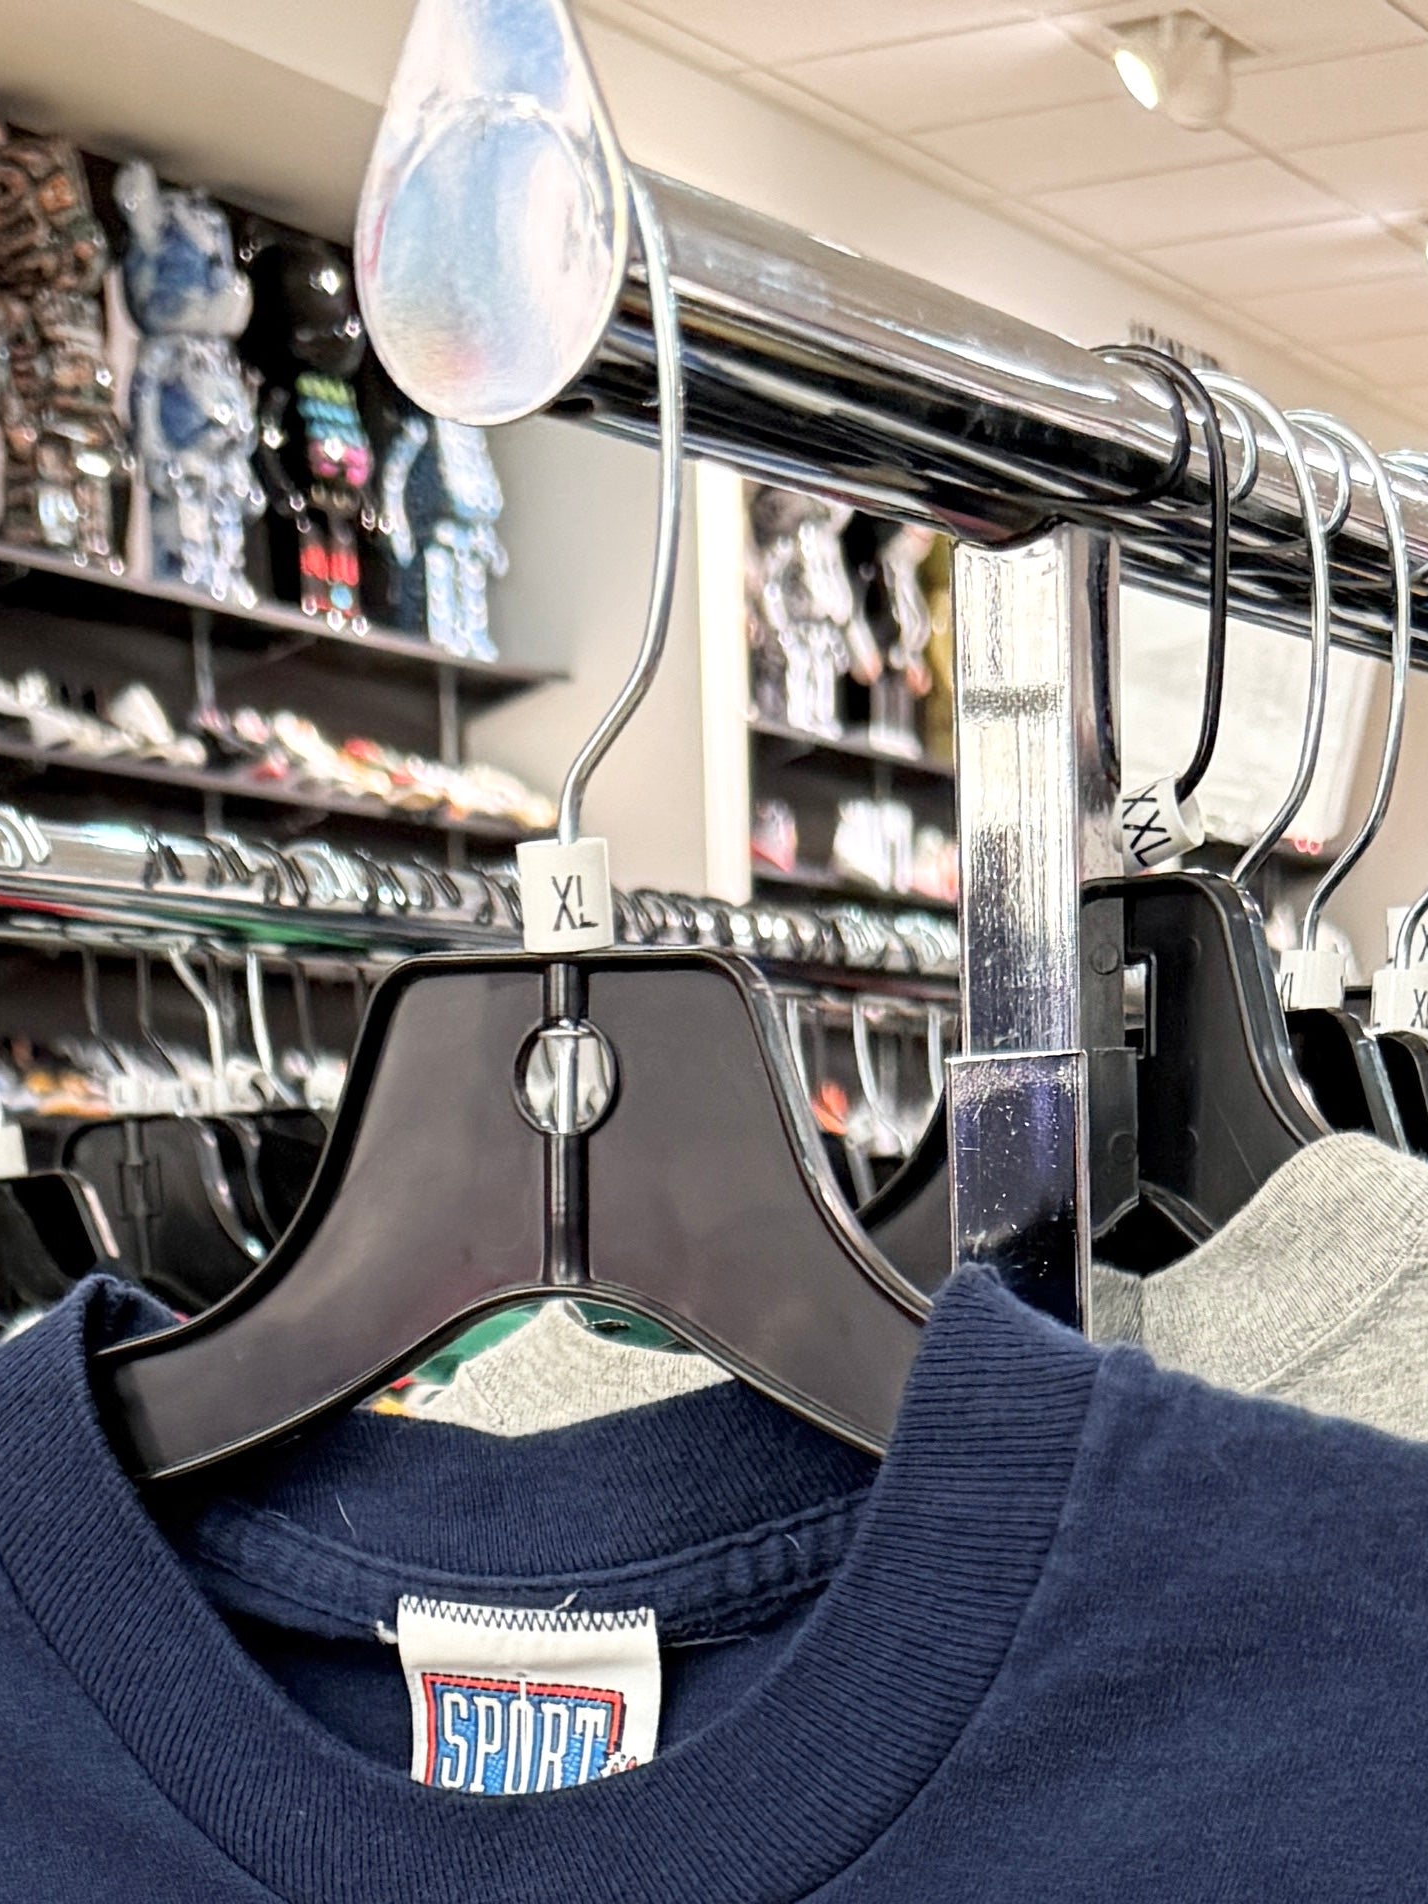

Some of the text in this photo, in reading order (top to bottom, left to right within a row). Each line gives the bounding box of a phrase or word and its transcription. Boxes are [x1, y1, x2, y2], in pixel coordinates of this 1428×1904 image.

[1122, 784, 1172, 868] XXL
[550, 874, 599, 932] XL
[439, 1690, 608, 1796] SPORT
